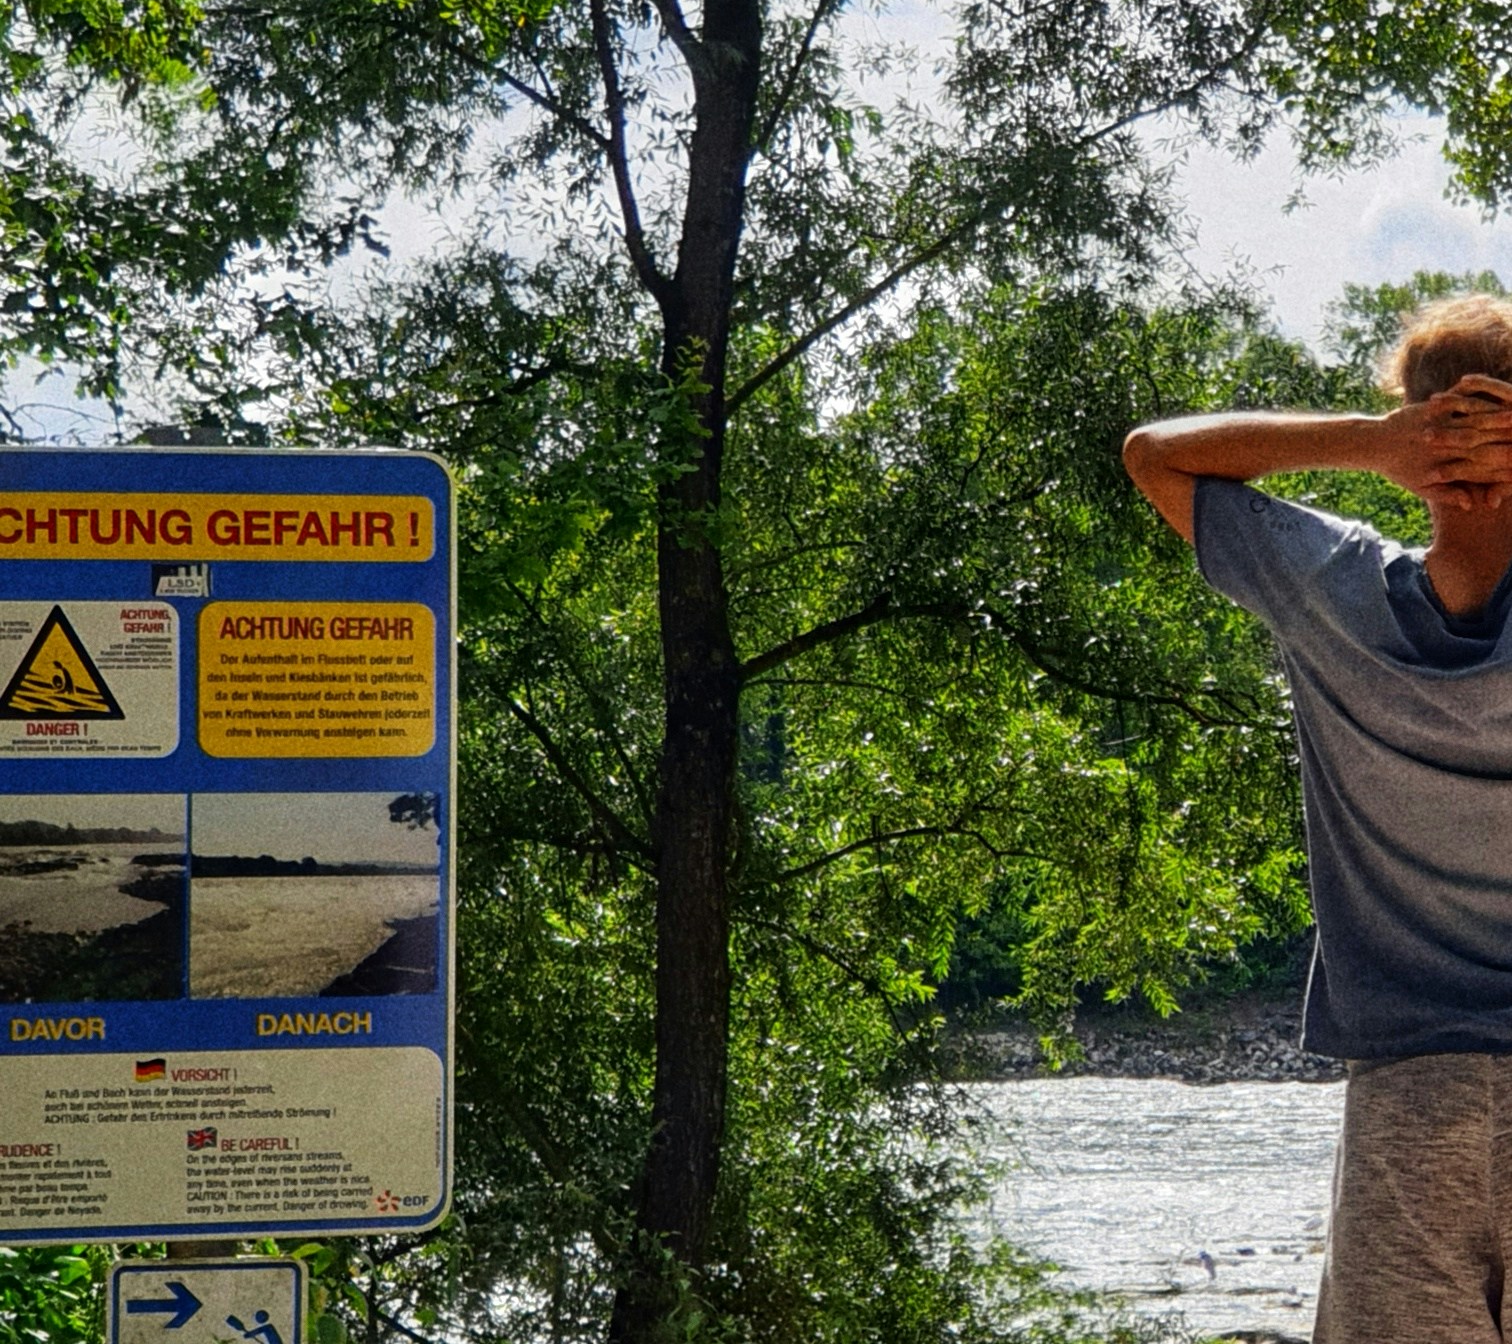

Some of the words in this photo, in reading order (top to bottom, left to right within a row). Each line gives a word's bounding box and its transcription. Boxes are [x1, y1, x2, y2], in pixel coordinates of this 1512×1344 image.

[0, 508, 192, 545] CHTUNG
[207, 510, 394, 546] GEFAHR
[220, 617, 324, 640] ACHTUNG
[330, 617, 413, 640] GEFAHR
[370, 654, 393, 665] oder
[207, 673, 227, 683] den
[266, 673, 286, 683] und
[215, 691, 228, 701] da
[232, 691, 248, 701] der
[325, 691, 355, 701] durch
[358, 691, 378, 701] den
[381, 691, 419, 701] Betrieb
[203, 711, 222, 720] von
[226, 709, 291, 720] Kraftwerken
[295, 709, 315, 719] und
[27, 723, 79, 736] DANGER
[226, 728, 252, 738] ohne
[11, 1018, 106, 1041] DAVOR
[257, 1012, 372, 1036] DANACH
[171, 1068, 230, 1081] VORSICHT
[44, 1113, 89, 1124] ACHTUNG
[221, 1139, 237, 1152] BE
[240, 1137, 293, 1152] CAREFUL
